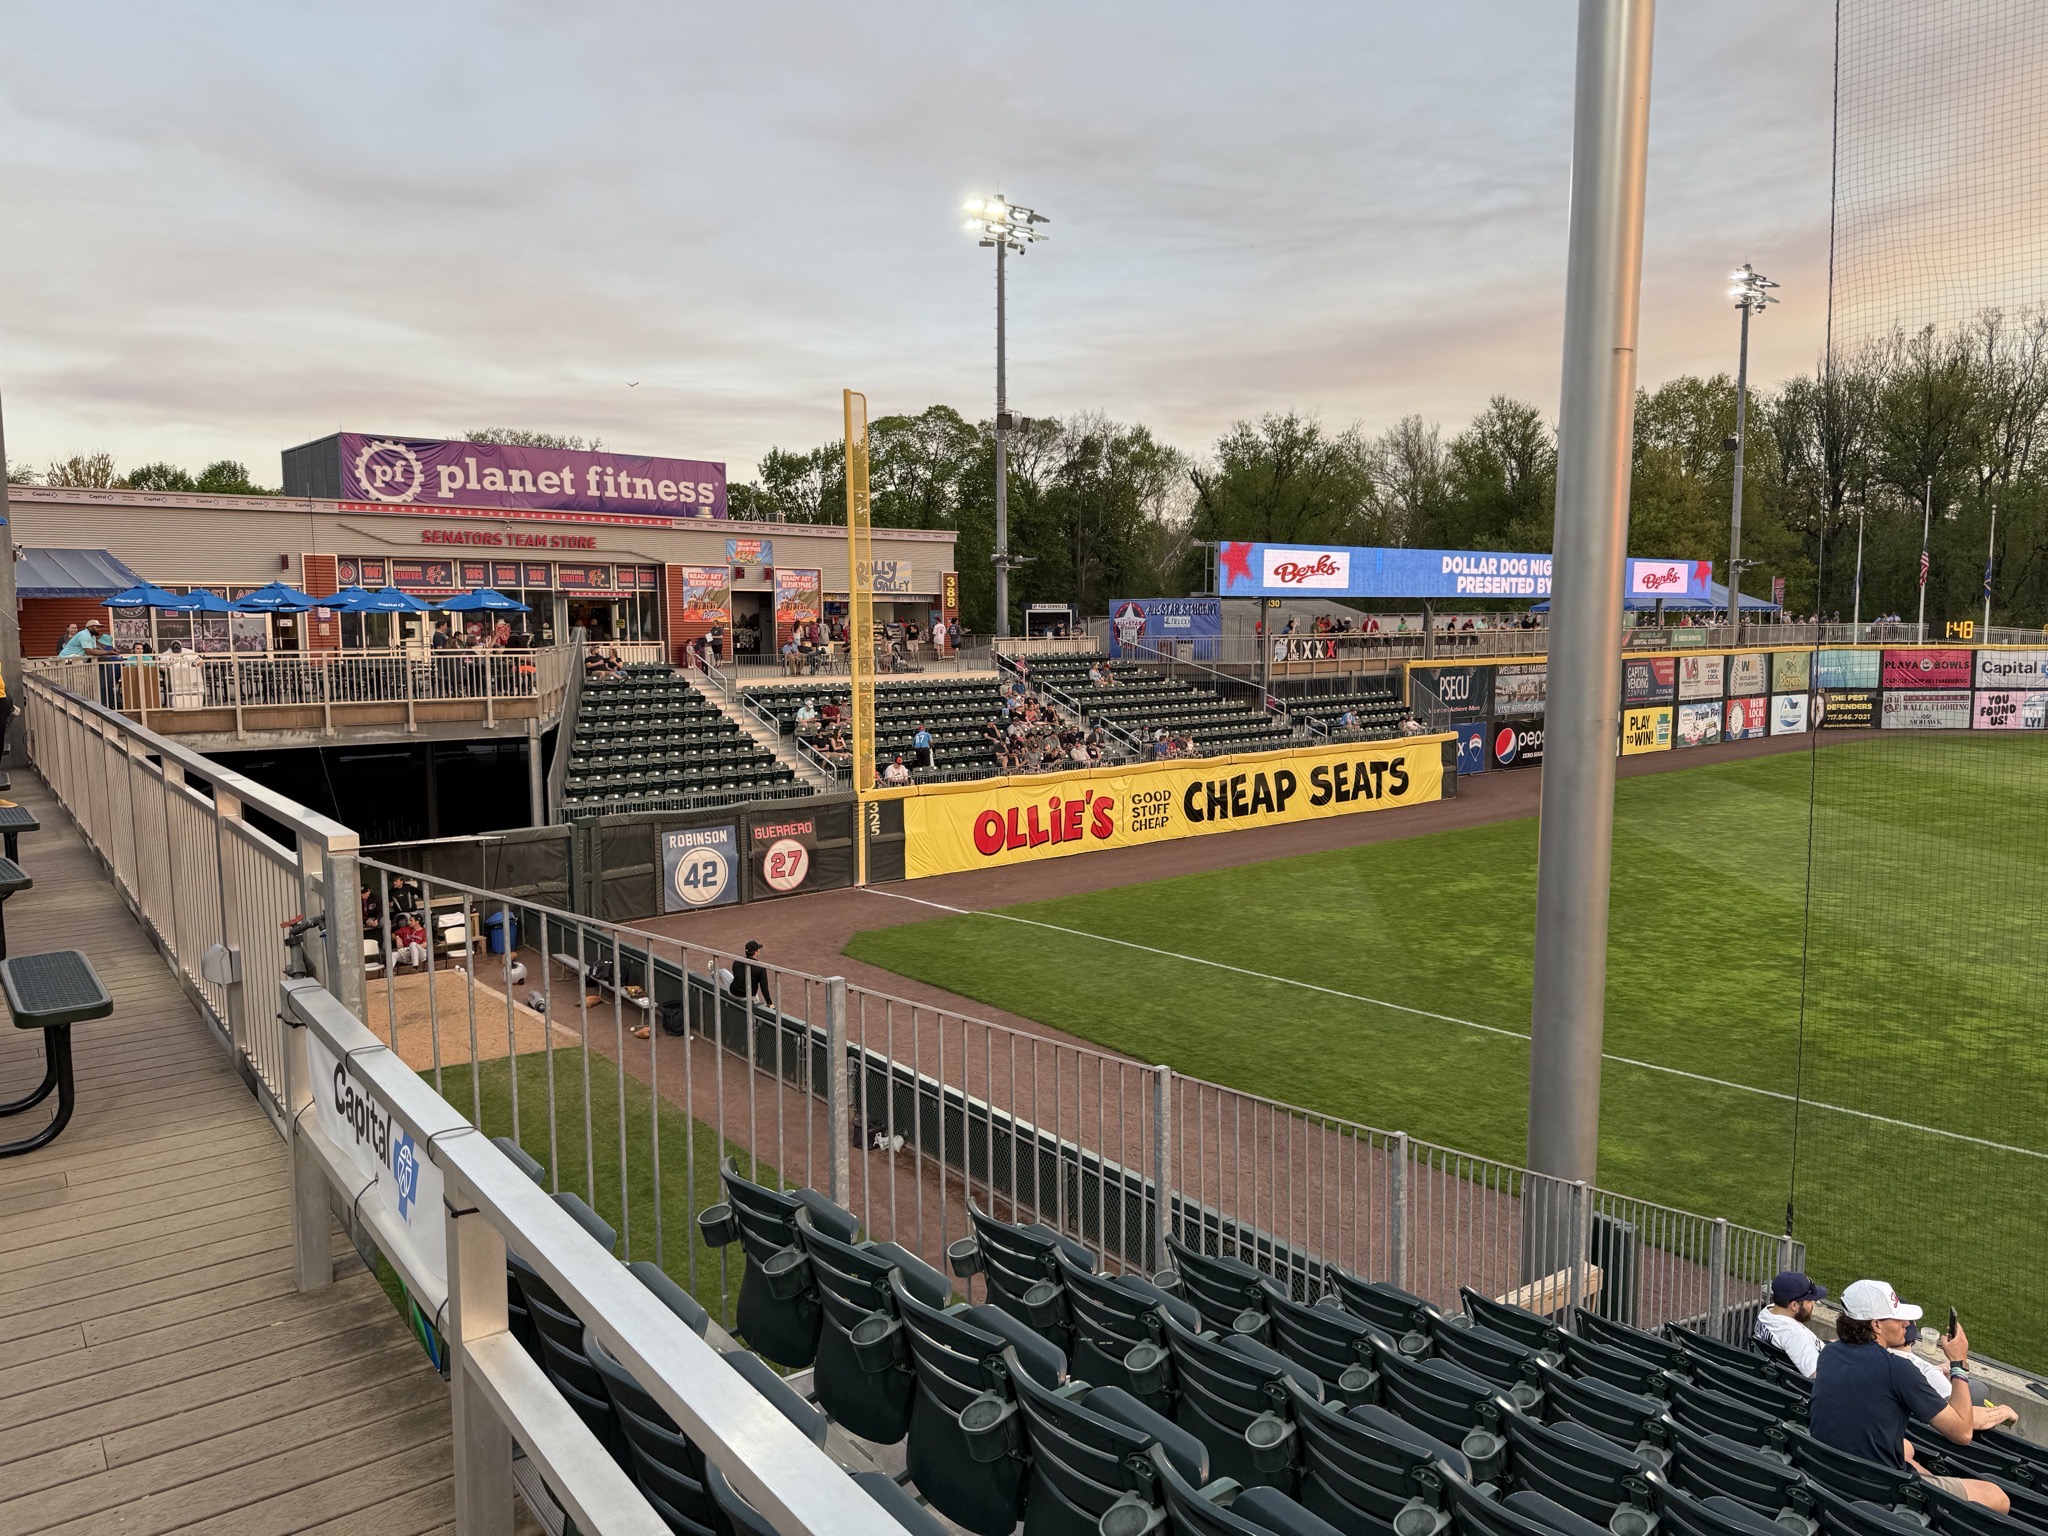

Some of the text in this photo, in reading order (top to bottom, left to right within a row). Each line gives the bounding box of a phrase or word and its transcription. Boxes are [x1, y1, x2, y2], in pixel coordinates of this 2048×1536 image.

[373, 461, 407, 487] pf
[437, 457, 715, 504] planet fitness
[422, 529, 597, 550] SENATORS TEAM STORE
[856, 560, 898, 586] RALLY
[1273, 554, 1341, 584] Berks
[1442, 556, 1553, 576] DOLLAR DOG NIG
[393, 571, 423, 580] SENATORS
[560, 574, 585, 583] SENATORS
[873, 575, 910, 592] GALLEY
[1642, 567, 1680, 590] Berks
[946, 576, 956, 608] 388
[1457, 576, 1553, 594] PRESENTED BY
[1945, 620, 1974, 639] 1:48
[1290, 639, 1297, 653] K
[1303, 640, 1336, 659] X X X
[1288, 652, 1300, 660] LINE
[1499, 664, 1547, 675] WELCOME TO HARRISB
[1627, 666, 1649, 679] CAPITAL
[1885, 661, 1970, 670] PLAYA BOWLS
[1982, 660, 2037, 676] Capital
[1440, 675, 1470, 701] PSECU
[1627, 677, 1649, 689] VENDING
[1627, 689, 1649, 697] COMPANY
[1831, 694, 1846, 702] THE
[1988, 694, 2010, 706] YOU
[1450, 705, 1468, 713] Achieve
[1695, 710, 1709, 721] Triple
[1710, 707, 1720, 719] Play
[1749, 708, 1764, 719] LOCAL
[1826, 703, 1873, 711] DEFENDERS
[1903, 703, 1923, 711] WALL
[1924, 703, 1930, 711] &
[1931, 703, 1969, 712] FLOORING
[1980, 704, 2017, 717] FOUND
[1630, 714, 1651, 732] PLAY
[1827, 713, 1871, 721] 717.546.7021
[1990, 715, 2008, 726] US!
[1518, 730, 1544, 751] pep
[1626, 730, 1654, 747] TO WIN!
[1131, 790, 1172, 805] GOOD
[1183, 757, 1409, 823] CHEAP SEATS
[869, 801, 881, 836] 325
[1132, 802, 1170, 818] STUFF
[669, 829, 728, 849] ROBINSON
[754, 821, 813, 840] GUERRERO
[770, 850, 803, 879] 27
[683, 860, 718, 889] 42
[333, 1061, 392, 1171] Capital
